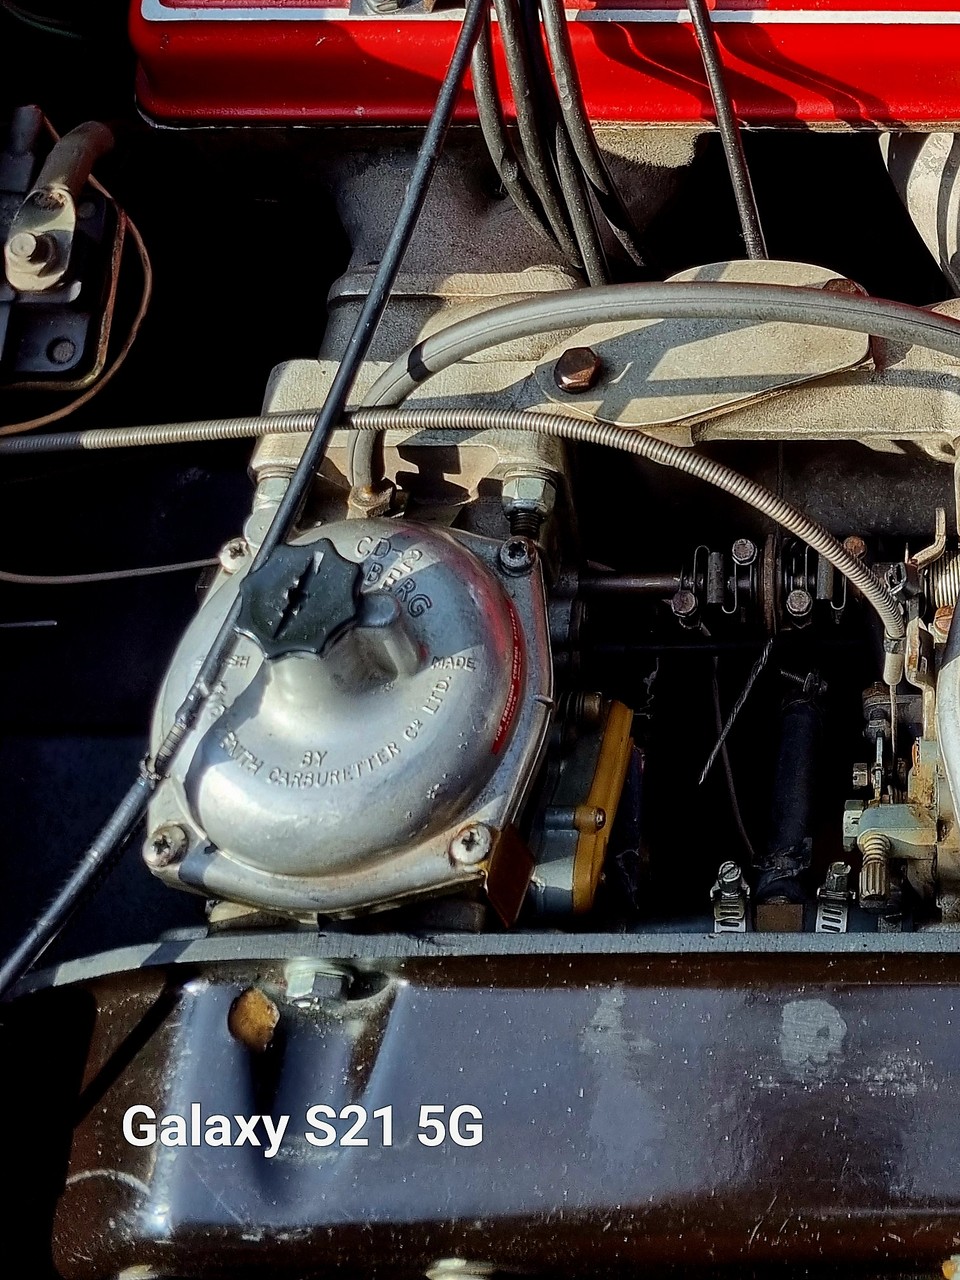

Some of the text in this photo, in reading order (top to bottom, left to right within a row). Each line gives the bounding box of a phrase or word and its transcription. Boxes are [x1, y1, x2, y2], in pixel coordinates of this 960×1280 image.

[364, 561, 433, 618] BERG
[431, 655, 477, 672] MADE
[267, 741, 402, 789] CARBURETTER
[301, 749, 328, 769] BY
